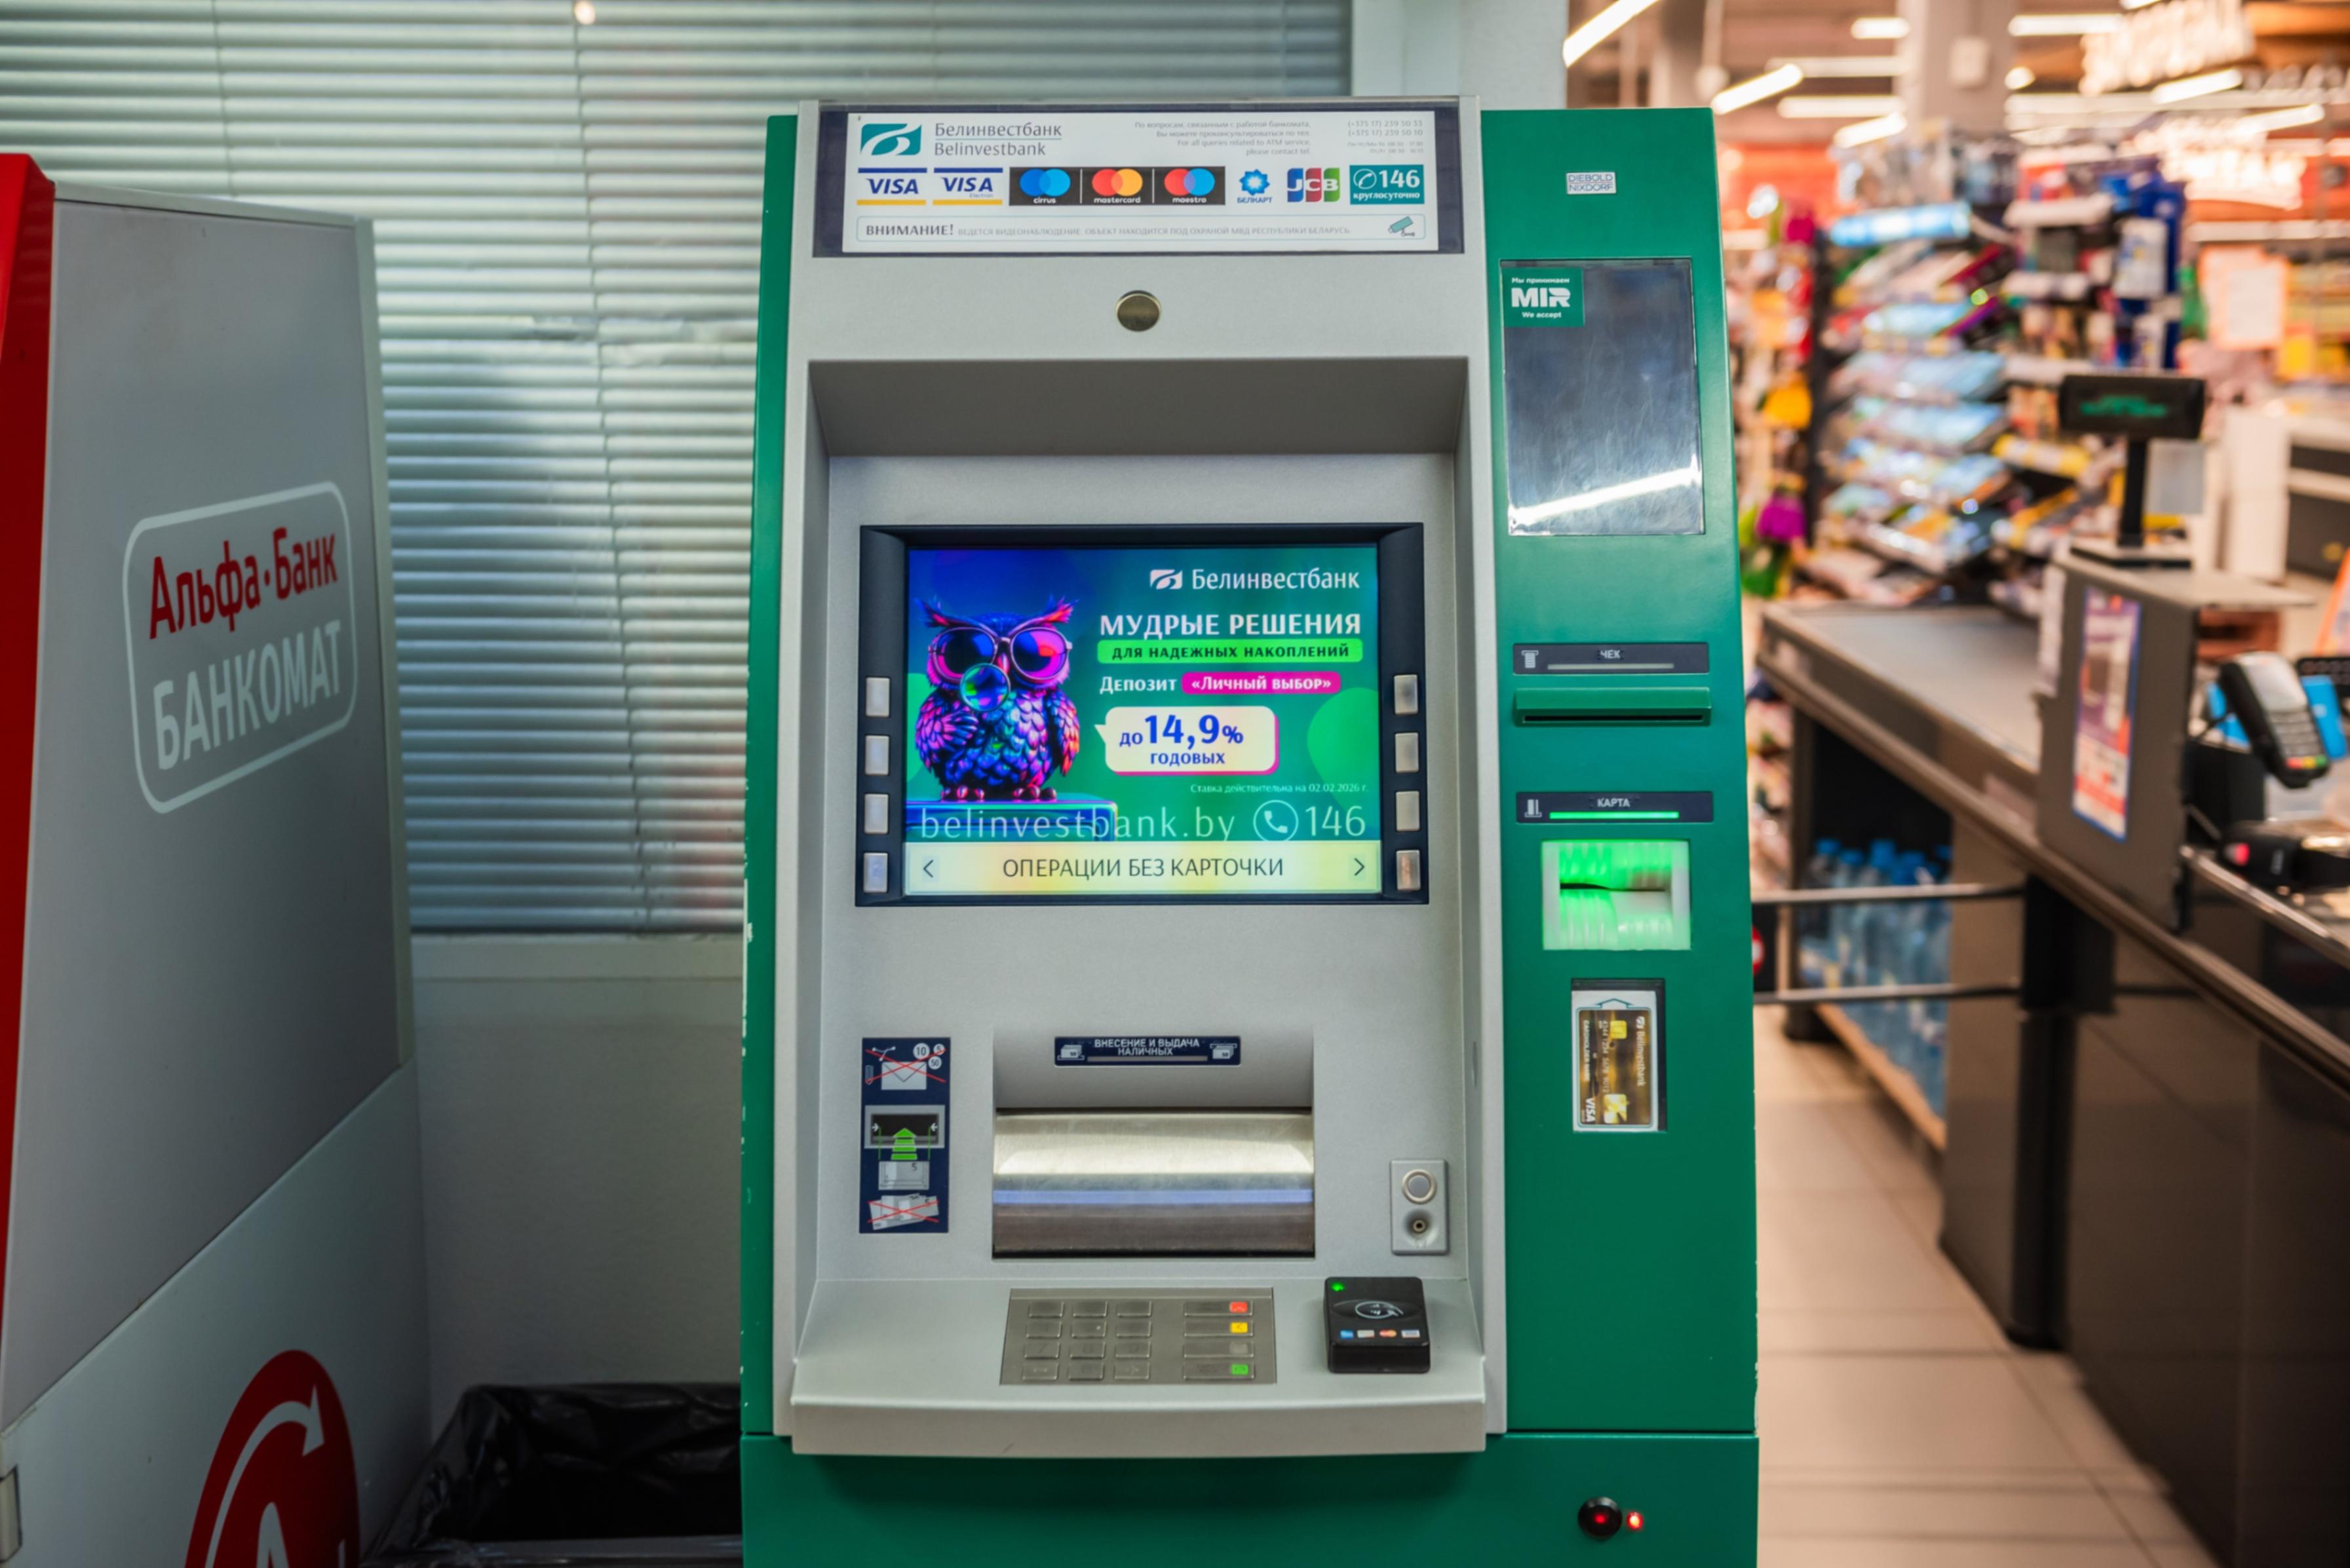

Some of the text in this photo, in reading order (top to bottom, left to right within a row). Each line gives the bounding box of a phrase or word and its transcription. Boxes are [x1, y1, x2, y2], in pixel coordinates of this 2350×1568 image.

[934, 122, 1062, 137] Белинвестбанк
[934, 142, 1046, 157] Belinvestbank
[865, 178, 919, 195] VISA
[941, 177, 993, 192] VISA
[1287, 179, 1338, 192] JCB
[1379, 170, 1420, 188] 146
[1353, 192, 1420, 202] круглосуточно
[866, 223, 954, 236] ВНИМАНИЕ!
[1511, 288, 1571, 307] MIR
[1191, 567, 1360, 590] Белинвестбанк
[1100, 613, 1360, 640] МУДРЫЕ РЕШЕНИЯ
[1112, 642, 1349, 660] ДЛЯ НАДЕЖНЫХ НАКОПЛЕНИЙ
[1600, 650, 1621, 659] ЧЕК
[153, 619, 341, 770] БАНКОМАТ
[1191, 784, 1223, 793] Ставка
[1224, 784, 1293, 794] действительна
[1309, 783, 1360, 792] 02.02.2026
[1597, 797, 1630, 807] КАРТА
[921, 805, 1366, 841] belinvestbank.by 146
[1003, 857, 1284, 880] ОПЕРАЦИИ БЕЗ КАРТОЧКИ
[1094, 1039, 1146, 1048] ВНЕСЕНИЕ
[1158, 1038, 1200, 1048] ВЫДАЧА
[917, 1047, 927, 1056] 10
[1118, 1047, 1173, 1056] НАЛИЧНЫХ
[1637, 1031, 1646, 1086] Belinvestbank
[1586, 1098, 1596, 1122] VISA
